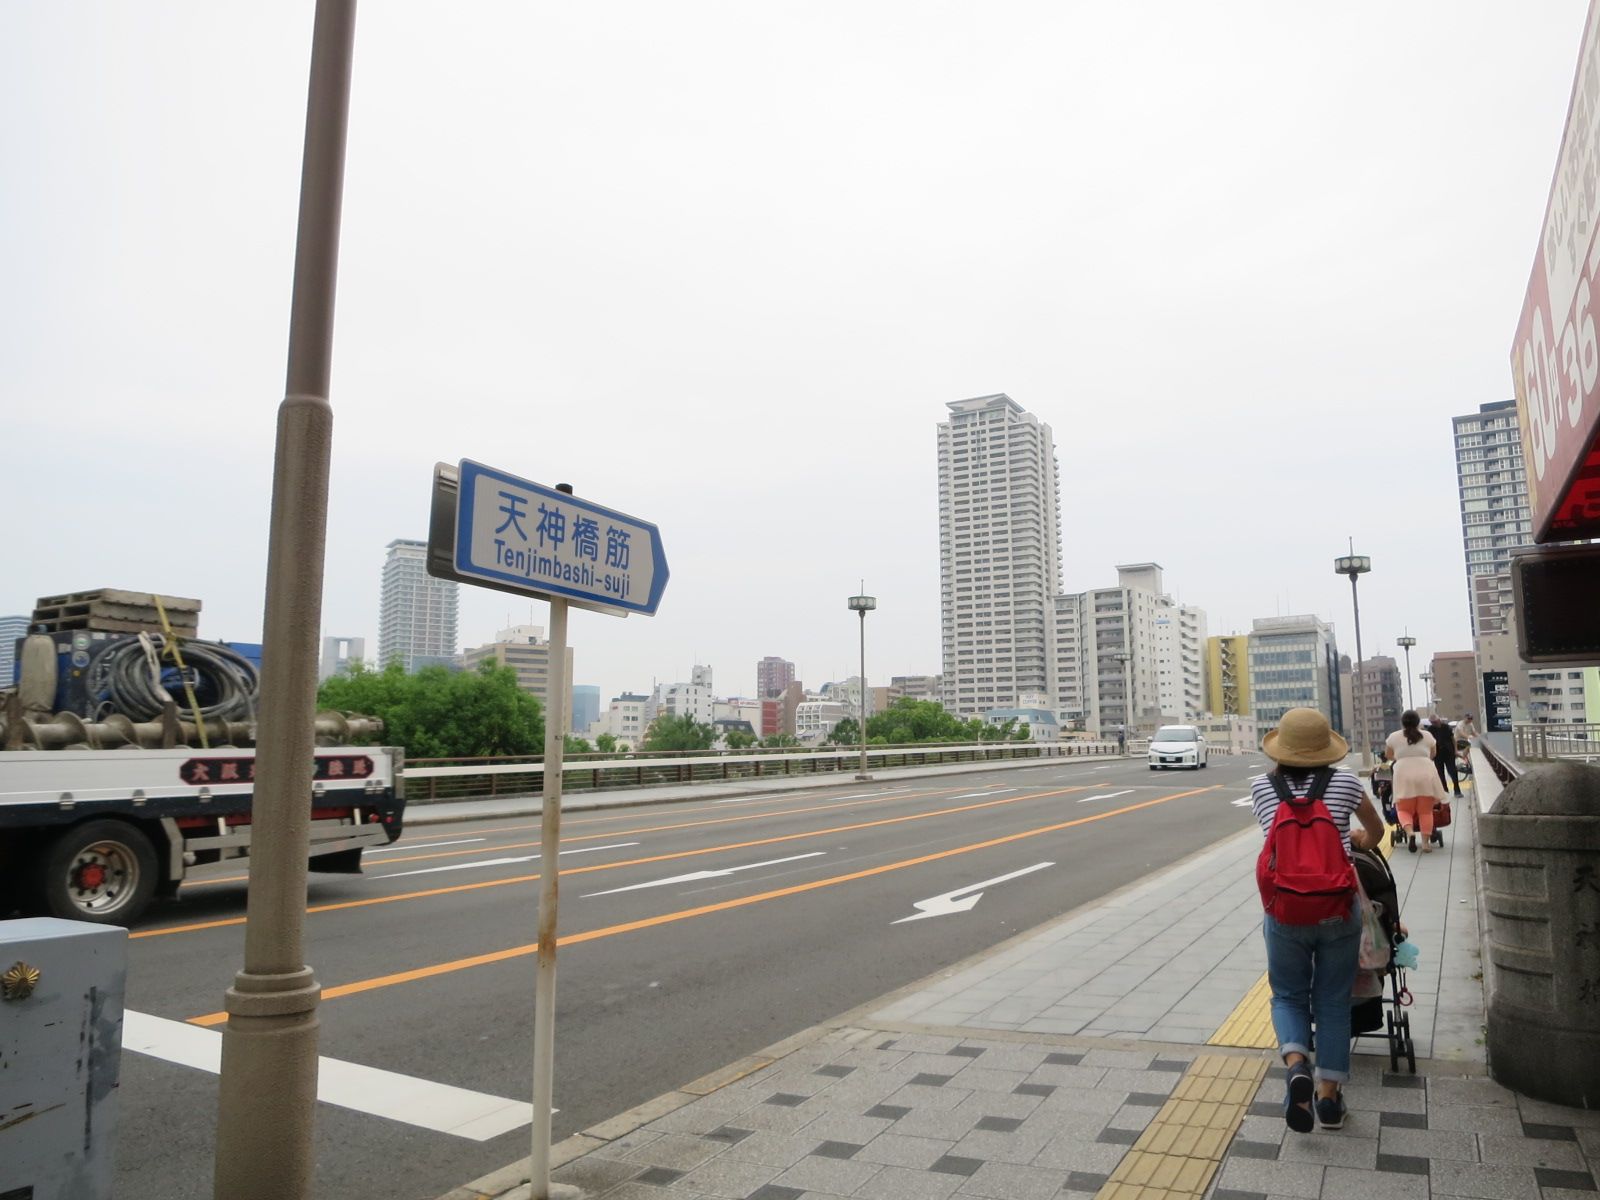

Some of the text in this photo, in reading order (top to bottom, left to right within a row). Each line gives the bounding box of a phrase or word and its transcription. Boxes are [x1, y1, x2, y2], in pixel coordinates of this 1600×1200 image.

[495, 490, 631, 571] 天神橋筋
[494, 538, 631, 599] Tenjimbashi-suji
